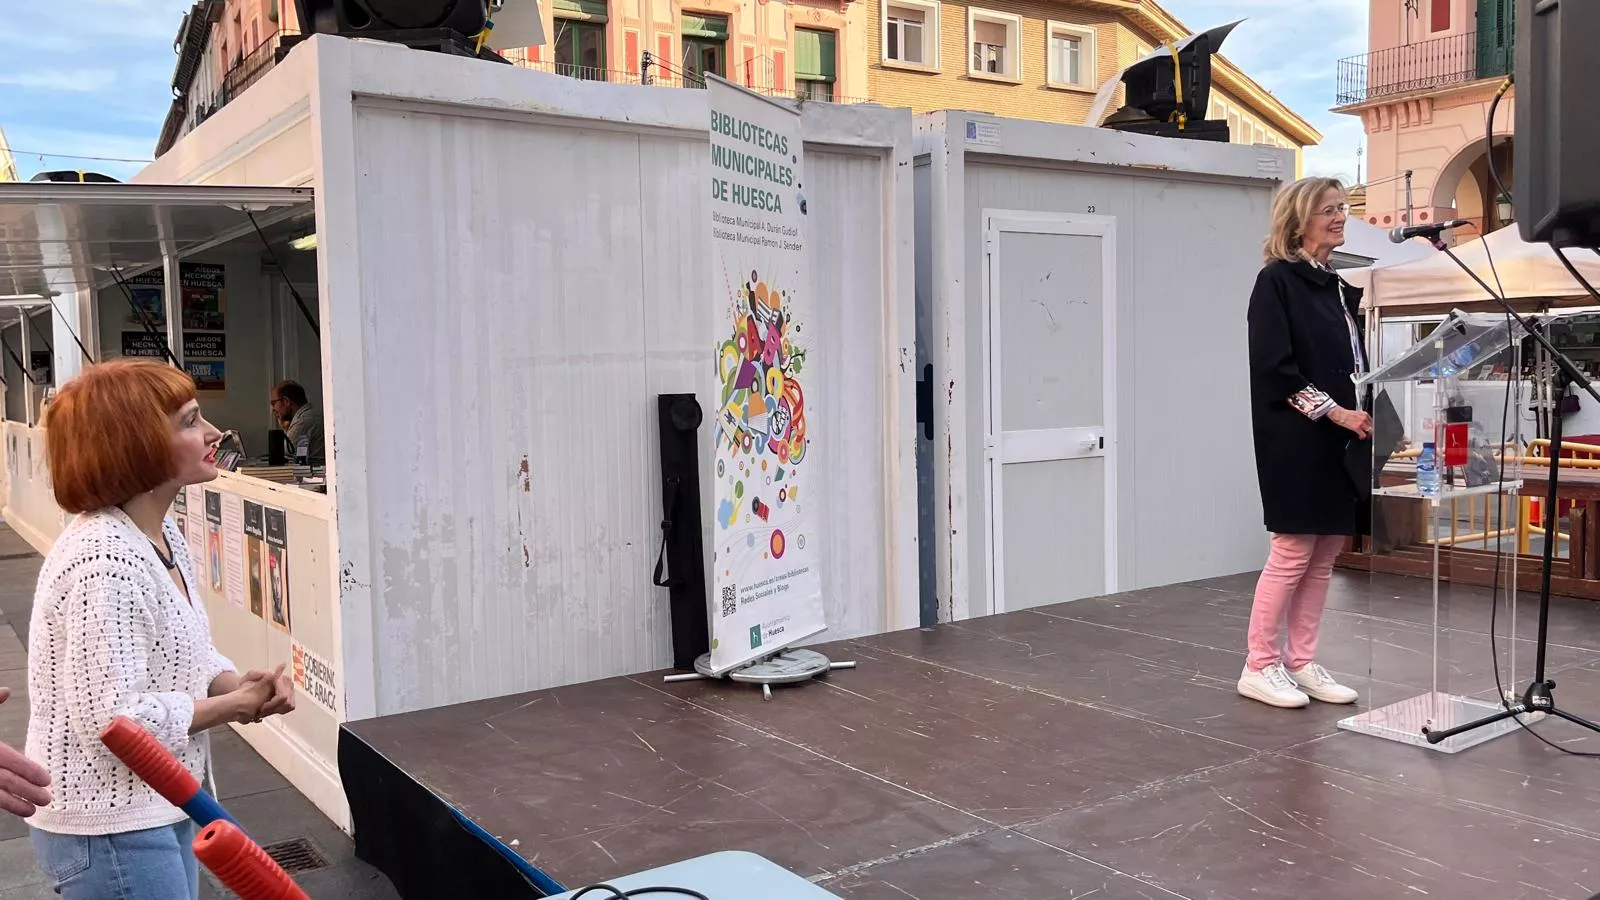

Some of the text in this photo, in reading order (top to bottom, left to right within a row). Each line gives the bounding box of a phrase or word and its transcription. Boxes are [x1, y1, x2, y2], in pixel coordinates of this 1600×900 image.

[711, 110, 788, 156] BIBLIOTECAS
[711, 143, 793, 187] MUNICIPALES
[712, 178, 782, 214] DE HUESCA
[1087, 205, 1096, 213] 23
[736, 216, 761, 230] Municipal
[736, 232, 761, 247] Municipal
[783, 240, 802, 251] Sender
[184, 271, 217, 280] HECHOS
[190, 280, 222, 288] HUESCA
[185, 341, 217, 349] HECHOS
[191, 349, 223, 357] HUESCA
[740, 595, 755, 605] Redes
[768, 626, 785, 637] Huesca
[304, 673, 314, 696] DE
